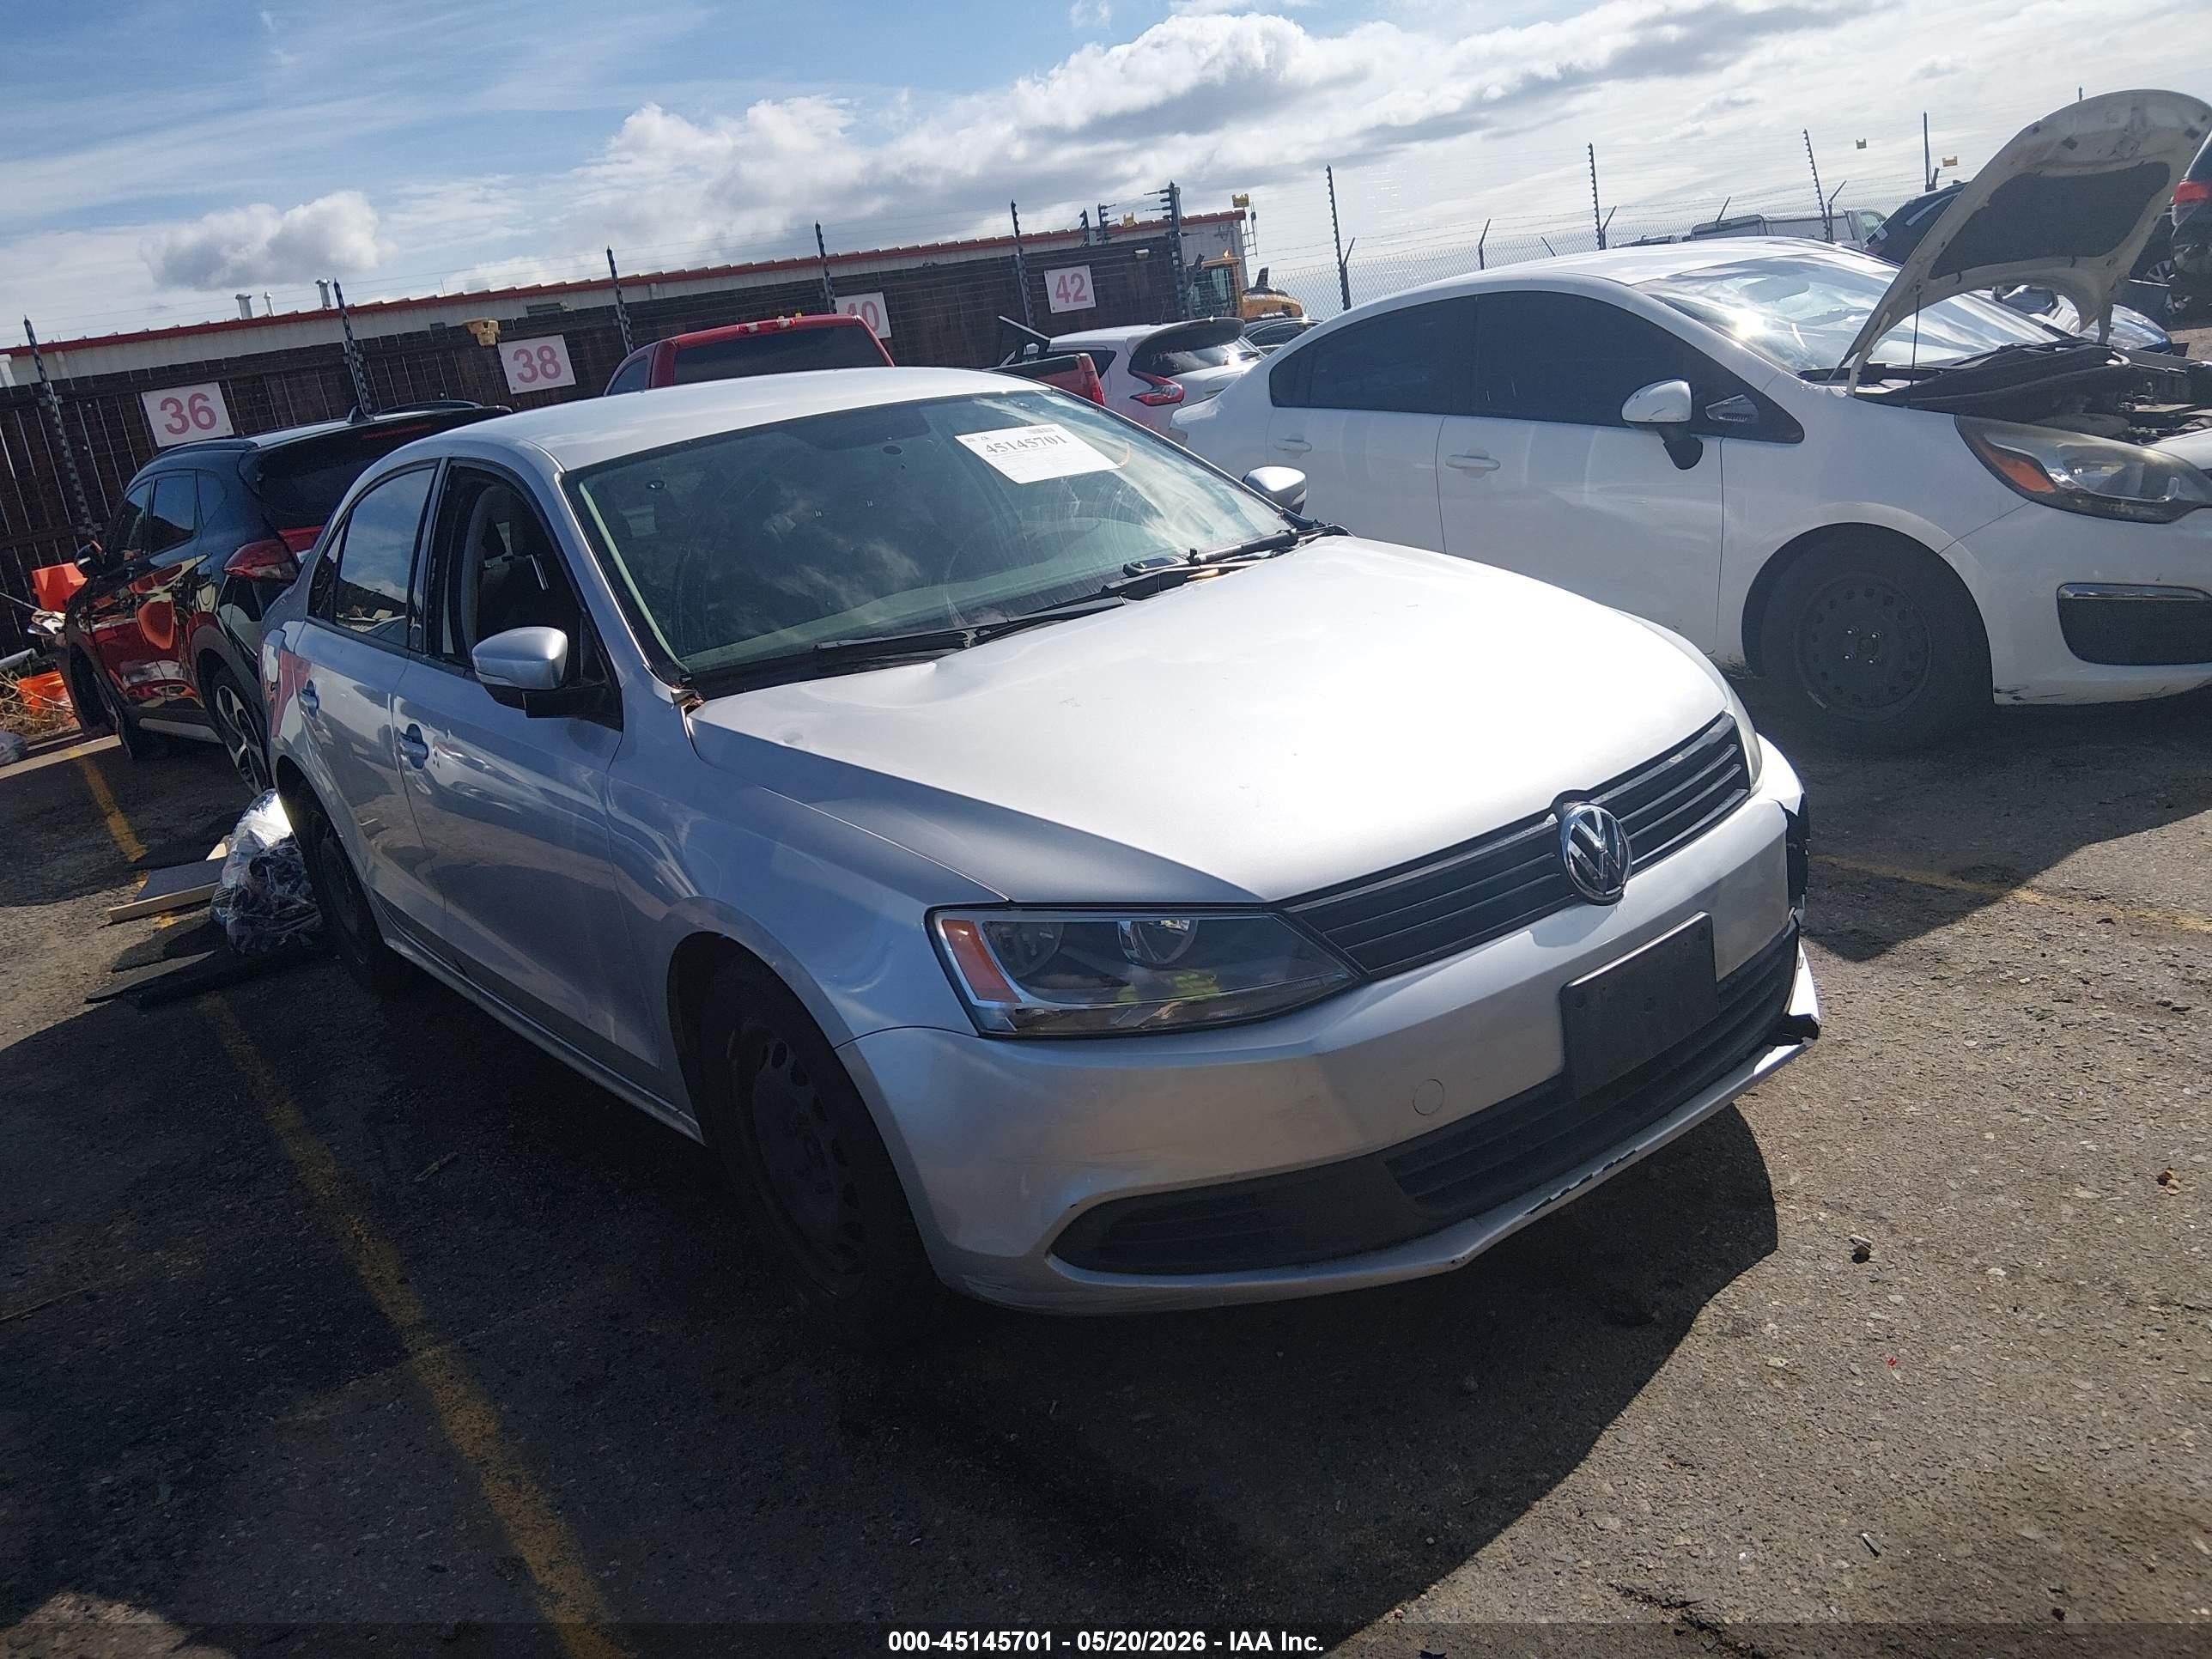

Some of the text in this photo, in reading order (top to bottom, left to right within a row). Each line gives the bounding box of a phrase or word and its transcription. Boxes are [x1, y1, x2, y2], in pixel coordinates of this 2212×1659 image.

[1055, 273, 1088, 303] 42
[513, 345, 562, 384] 38
[160, 392, 217, 435] 36
[986, 434, 1068, 454] 45145701
